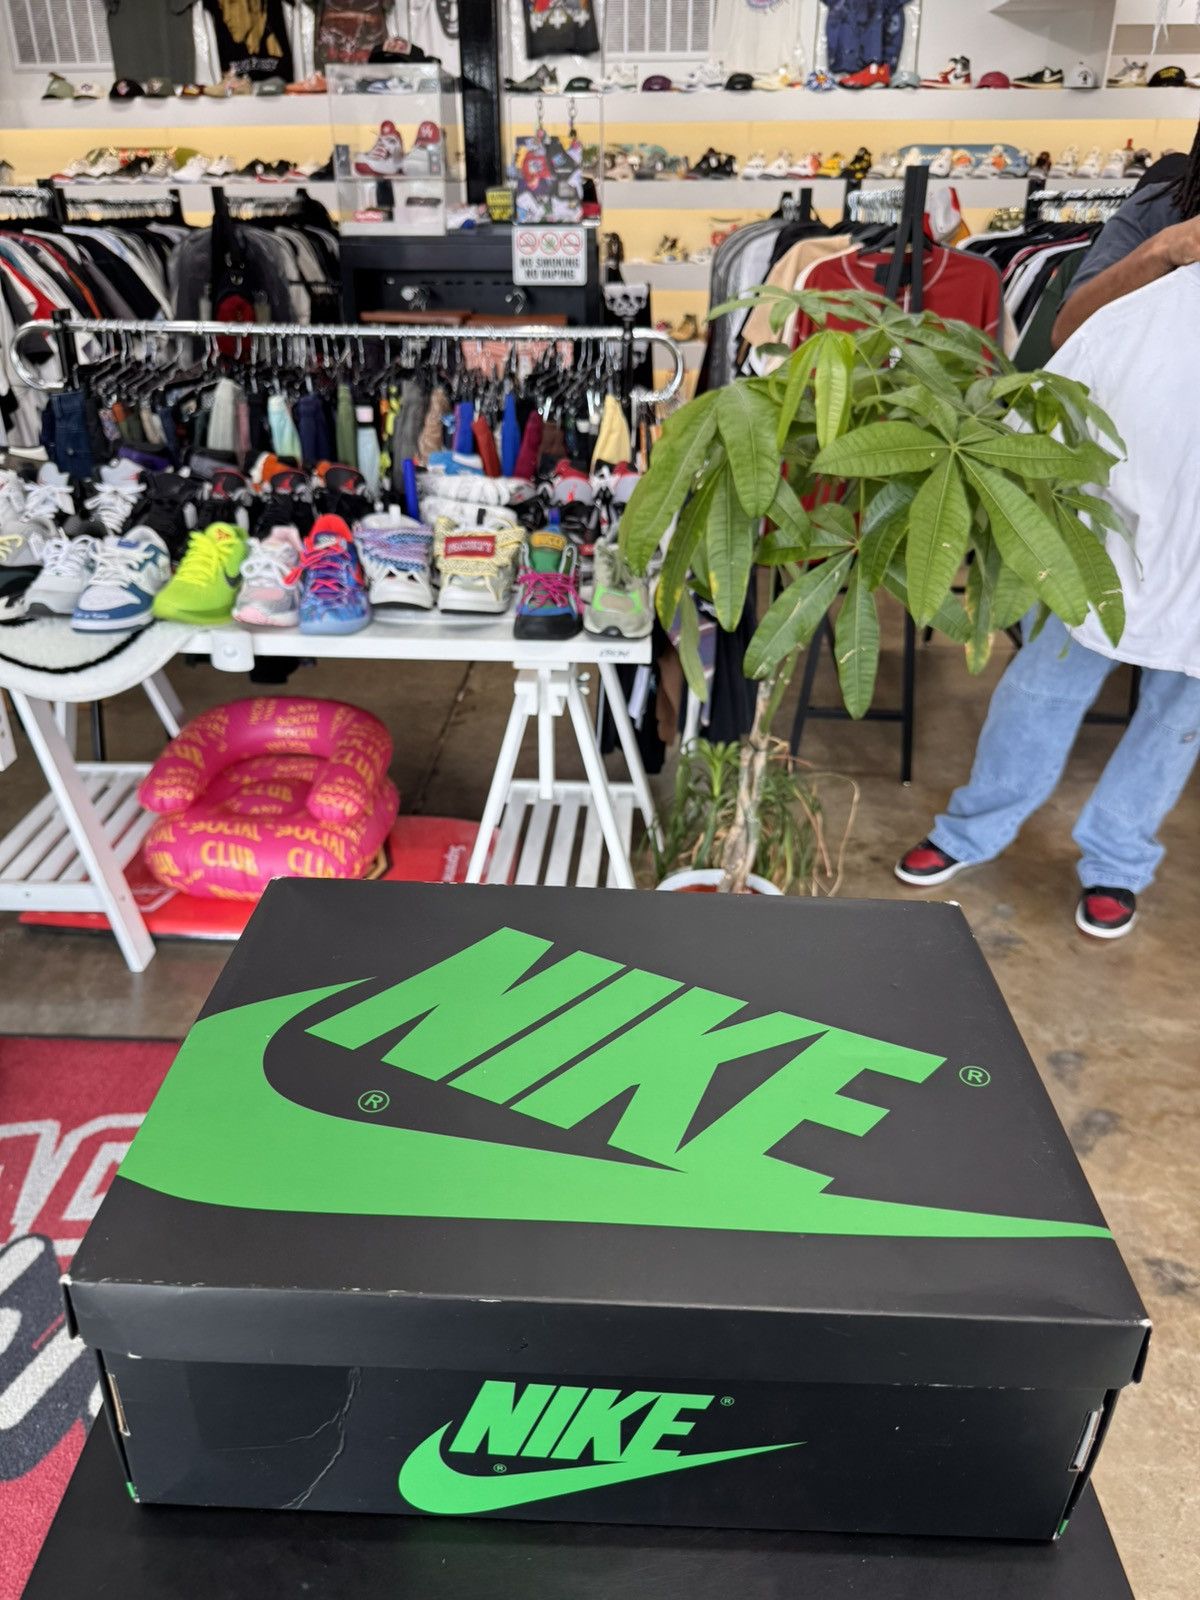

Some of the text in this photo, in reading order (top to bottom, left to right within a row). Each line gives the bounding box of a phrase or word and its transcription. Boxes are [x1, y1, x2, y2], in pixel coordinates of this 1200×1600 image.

[519, 258, 533, 268] NO
[524, 269, 538, 279] NO
[200, 840, 260, 877] CLUB
[304, 926, 948, 1194] NIKE
[448, 1380, 716, 1463] NIKE
